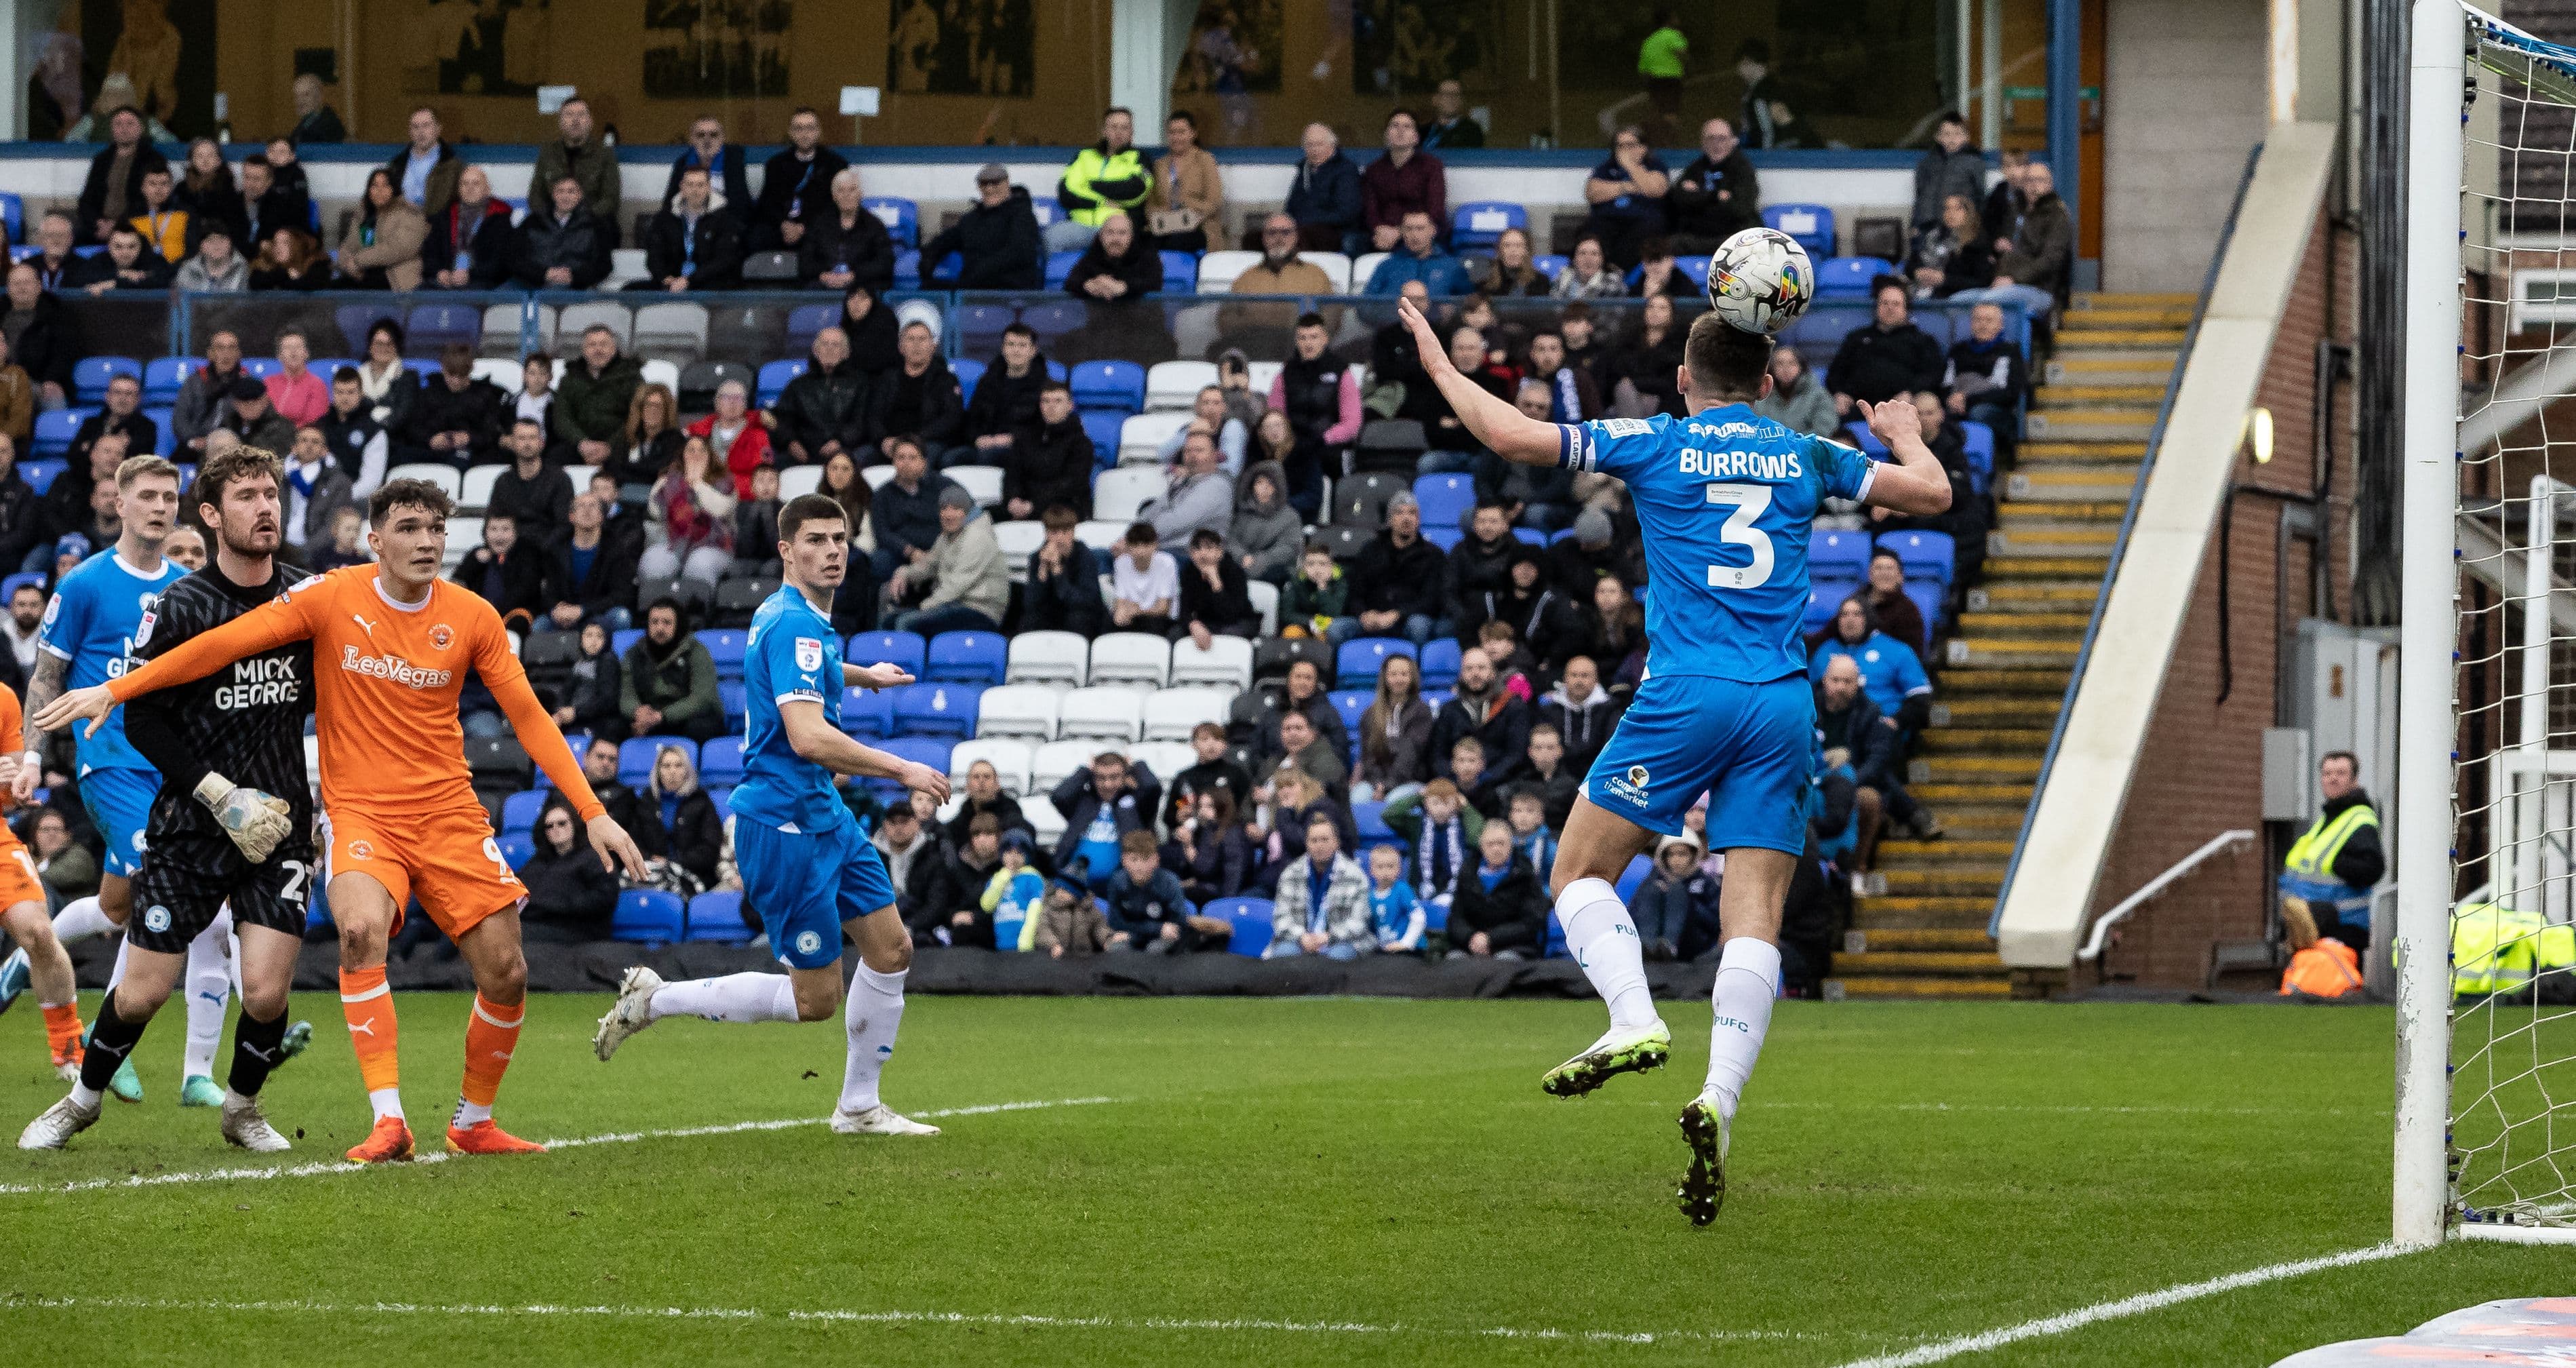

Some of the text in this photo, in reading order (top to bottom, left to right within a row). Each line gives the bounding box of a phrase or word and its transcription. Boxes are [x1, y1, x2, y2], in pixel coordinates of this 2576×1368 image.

[1680, 448, 1802, 479] BURROWS
[1706, 483, 1775, 589] 3
[235, 655, 296, 683] MICK
[342, 644, 452, 690] LeoVegas
[1612, 776, 1649, 799] compare
[482, 836, 507, 876] 9
[1615, 924, 1637, 938] PUF
[1713, 1015, 1749, 1032] PUFC
